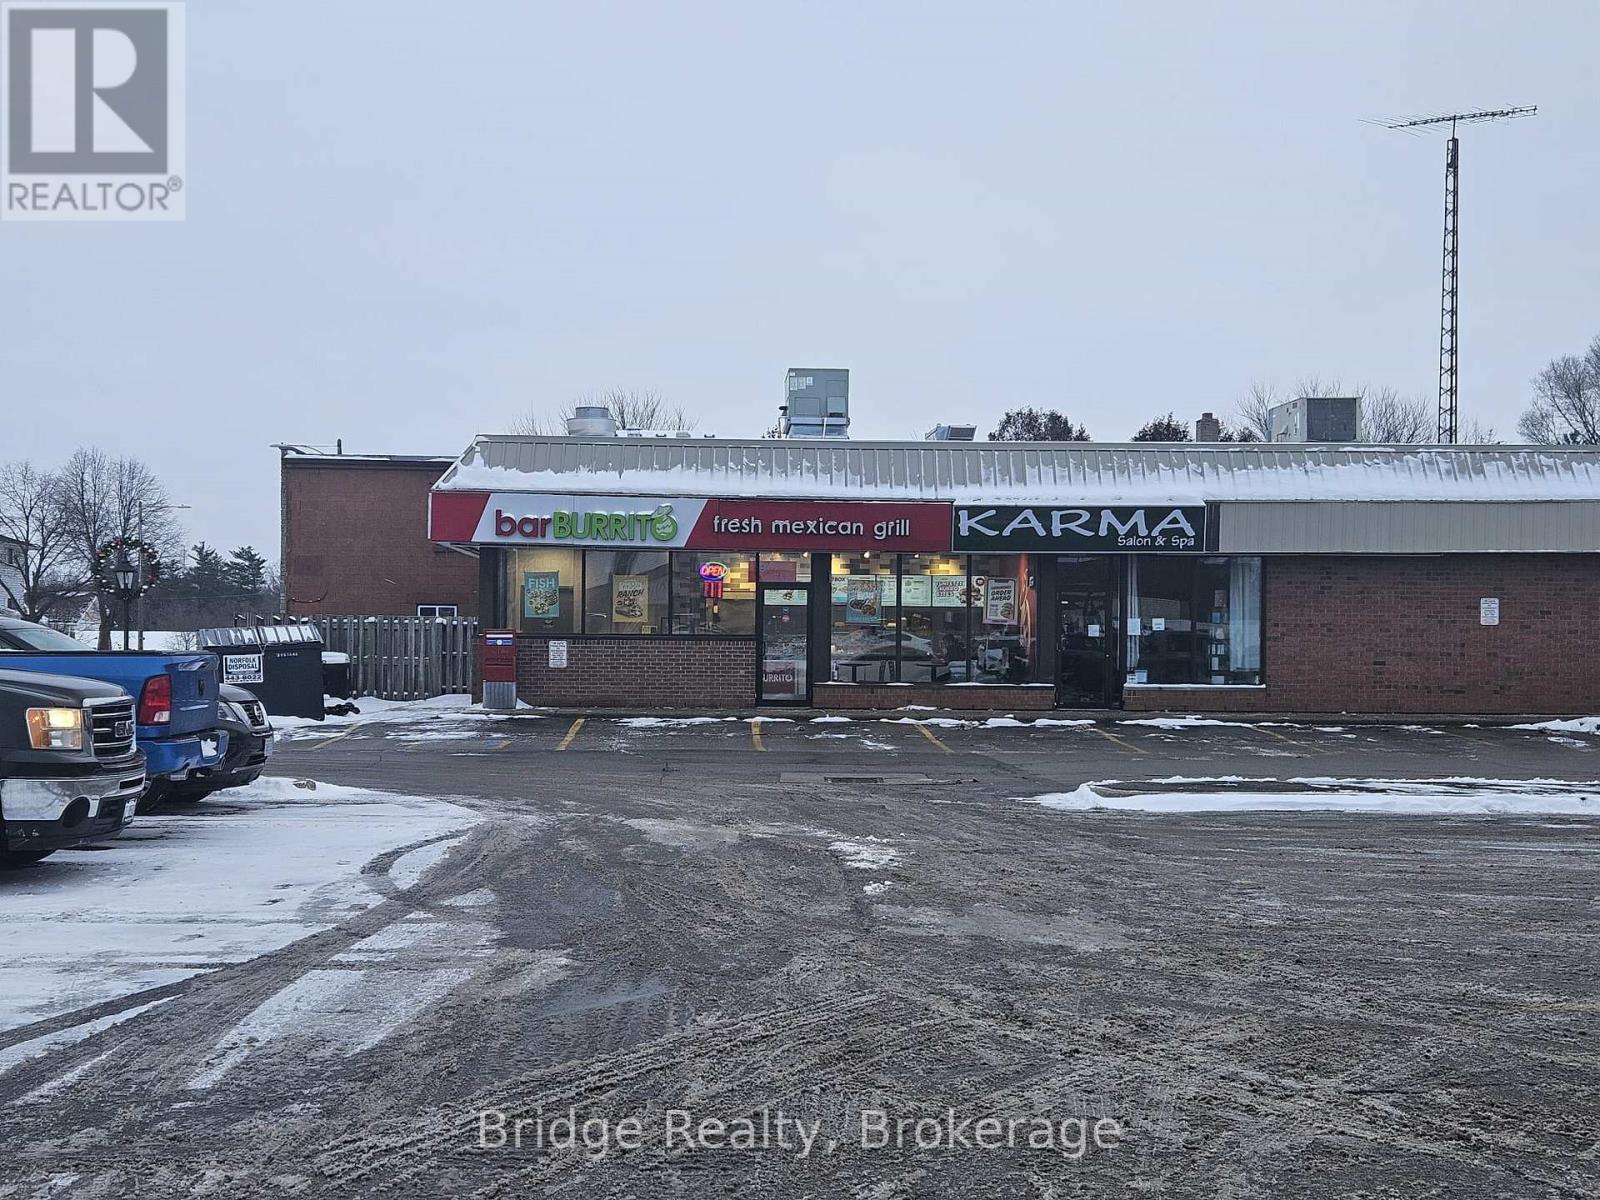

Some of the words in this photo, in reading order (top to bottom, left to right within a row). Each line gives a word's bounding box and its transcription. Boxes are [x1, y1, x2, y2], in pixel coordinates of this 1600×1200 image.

[713, 515, 762, 533] fresh
[771, 517, 864, 535] mexican
[873, 519, 910, 540] grill
[957, 508, 1196, 538] KARMA
[1117, 535, 1151, 546] Salon
[1154, 535, 1167, 546] &
[1171, 535, 1195, 549] Spa
[701, 563, 726, 577] OPEN
[528, 578, 555, 588] FISH
[616, 589, 644, 599] RANCH
[229, 656, 256, 664] NORFOLK
